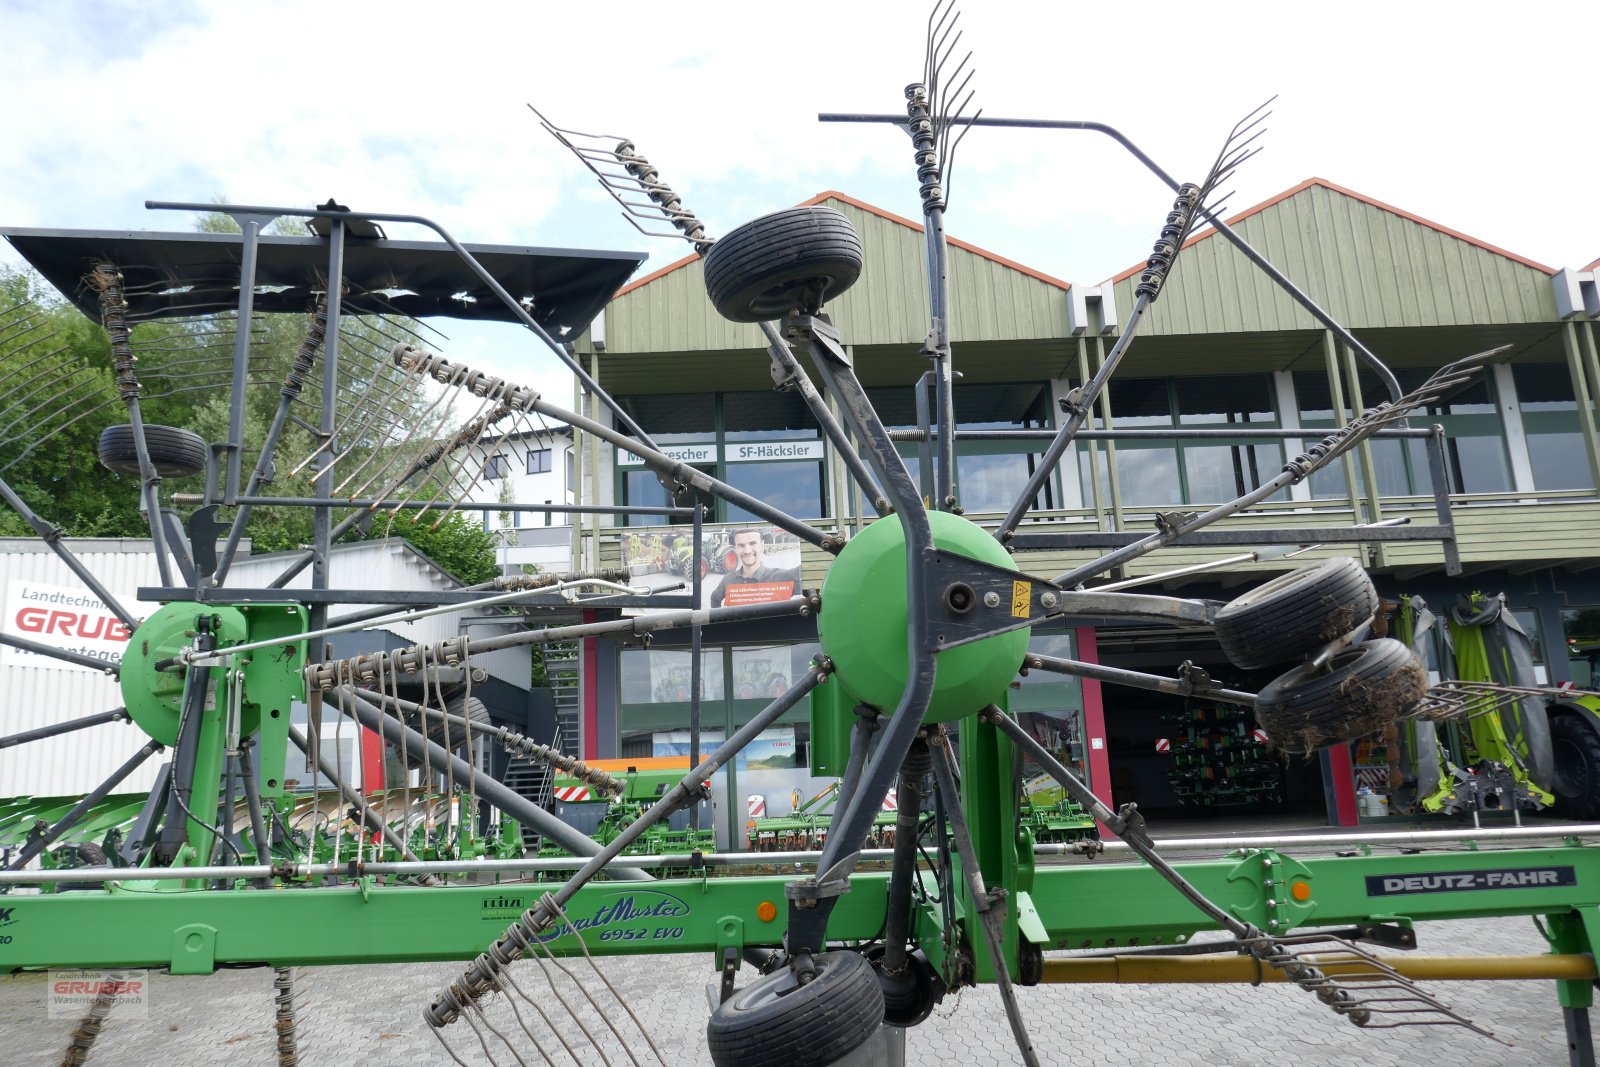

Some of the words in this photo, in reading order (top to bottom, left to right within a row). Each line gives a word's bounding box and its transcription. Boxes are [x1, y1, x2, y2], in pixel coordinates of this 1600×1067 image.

[627, 448, 709, 462] Mrescher
[739, 445, 809, 458] SF-Häcksler
[15, 607, 130, 642] GRUB
[1384, 870, 1558, 892] DEUTZ-FAHR
[600, 927, 648, 941] 6952
[653, 926, 685, 939] EVO
